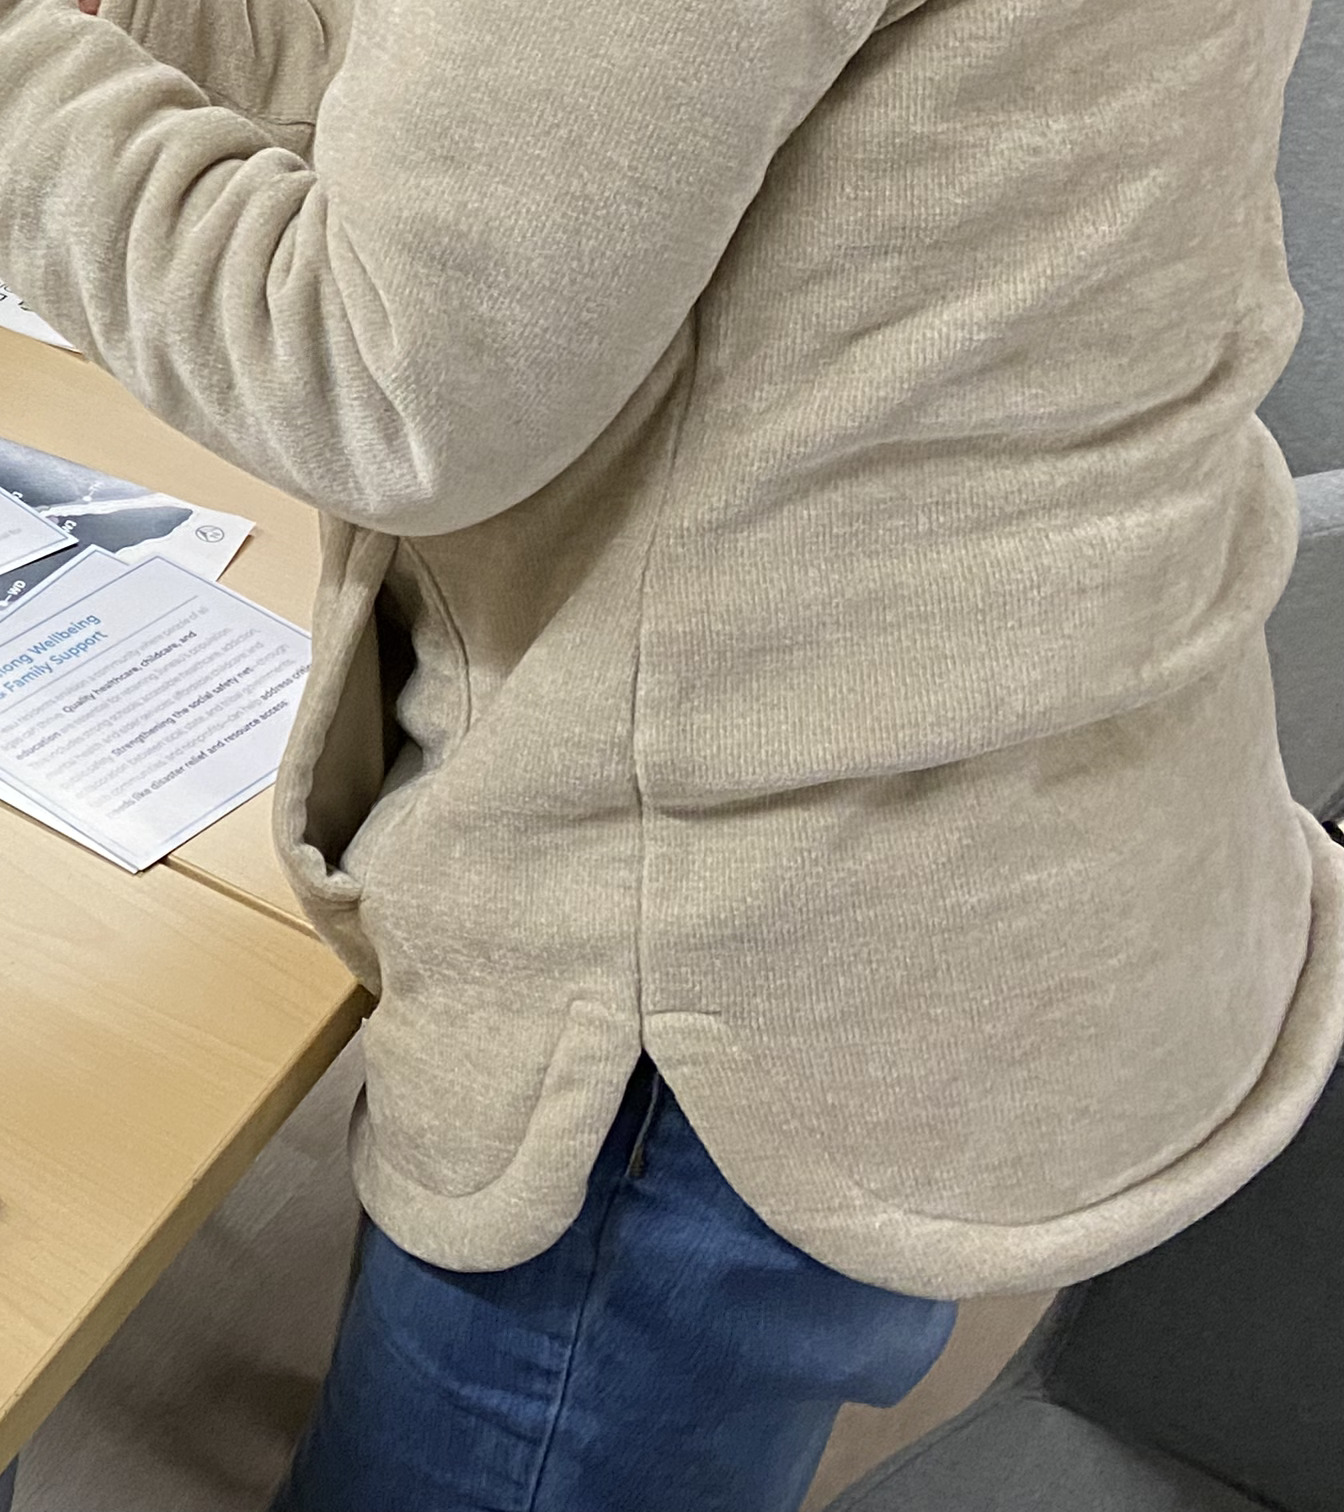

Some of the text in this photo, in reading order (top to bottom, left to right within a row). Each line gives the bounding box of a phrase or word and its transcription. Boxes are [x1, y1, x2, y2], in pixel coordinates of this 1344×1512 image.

[5, 579, 28, 596] WD
[26, 613, 102, 655] Wellbeing
[1, 661, 55, 693] Family
[47, 629, 110, 665] Support
